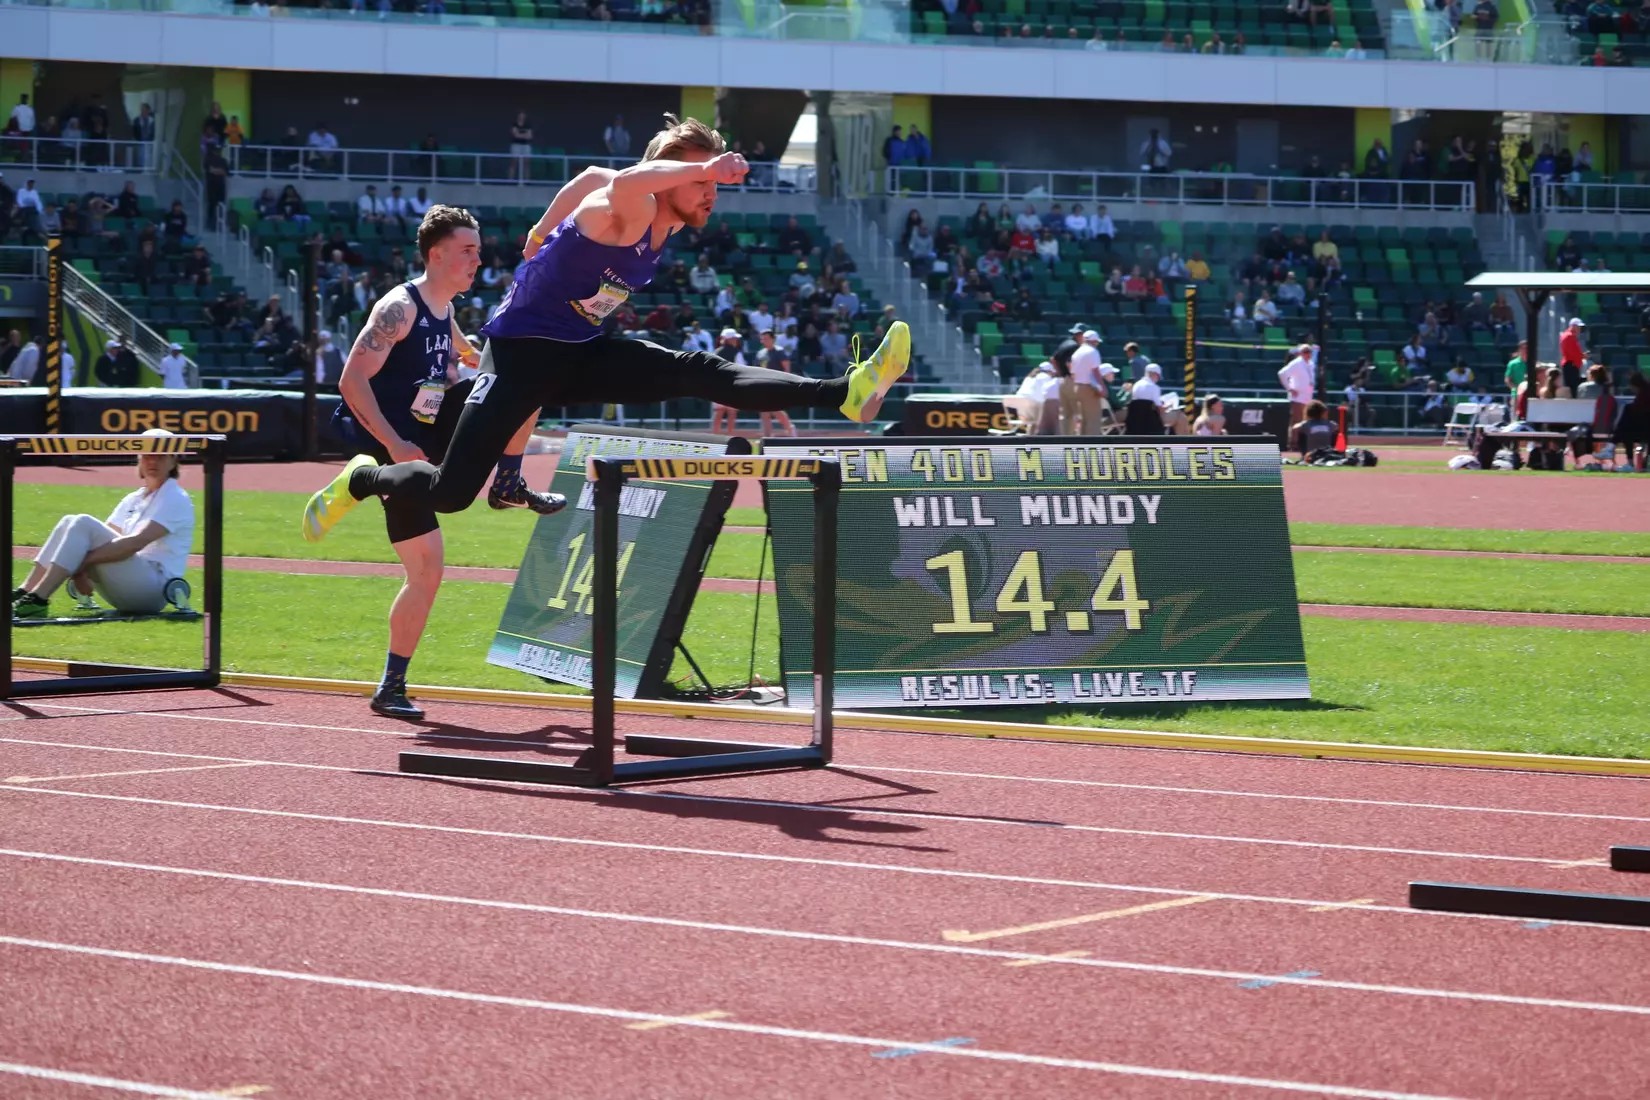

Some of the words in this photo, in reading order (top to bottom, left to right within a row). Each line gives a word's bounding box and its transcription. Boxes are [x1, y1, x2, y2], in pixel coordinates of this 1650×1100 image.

[425, 333, 452, 357] LAN
[470, 376, 490, 401] 2
[101, 408, 259, 432] OREGON
[76, 439, 143, 451] DUCKS
[684, 461, 754, 475] DUCKS
[809, 449, 888, 482] EN
[911, 448, 995, 482] 400
[1015, 448, 1044, 481] M
[1063, 447, 1237, 481] HURDLES
[893, 495, 997, 528] WILL
[1019, 495, 1162, 526] MUNDY
[925, 548, 1150, 634] 14.4
[901, 673, 1055, 701] RESULTS:
[1072, 671, 1198, 698] LIVE.TF
